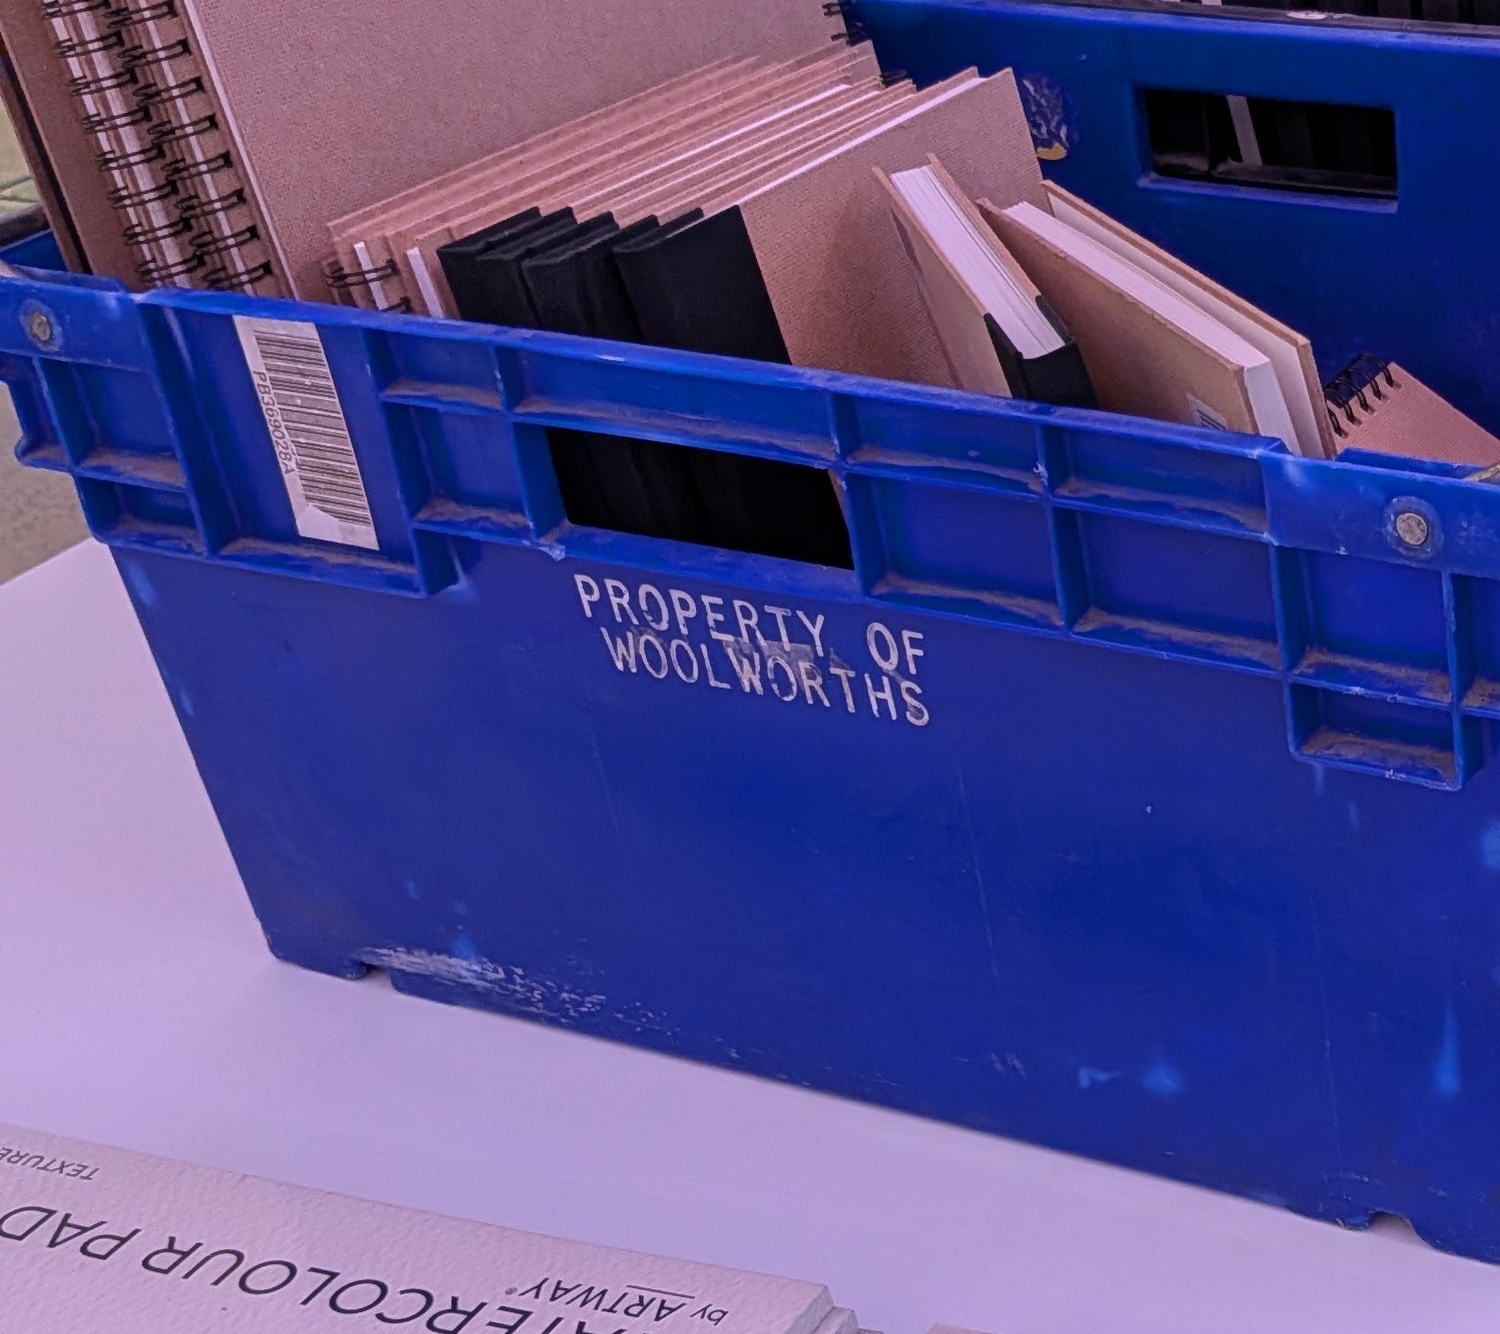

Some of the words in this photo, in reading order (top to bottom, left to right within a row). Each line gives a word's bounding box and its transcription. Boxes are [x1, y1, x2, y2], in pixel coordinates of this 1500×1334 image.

[252, 369, 295, 476] PB369028A
[573, 573, 825, 658] PROPERTY
[866, 621, 924, 675] OF
[600, 626, 931, 727] WOOLWORTHS
[0, 1146, 100, 1181] TEXTURE
[0, 1205, 143, 1261] PAD
[689, 1303, 730, 1326] by
